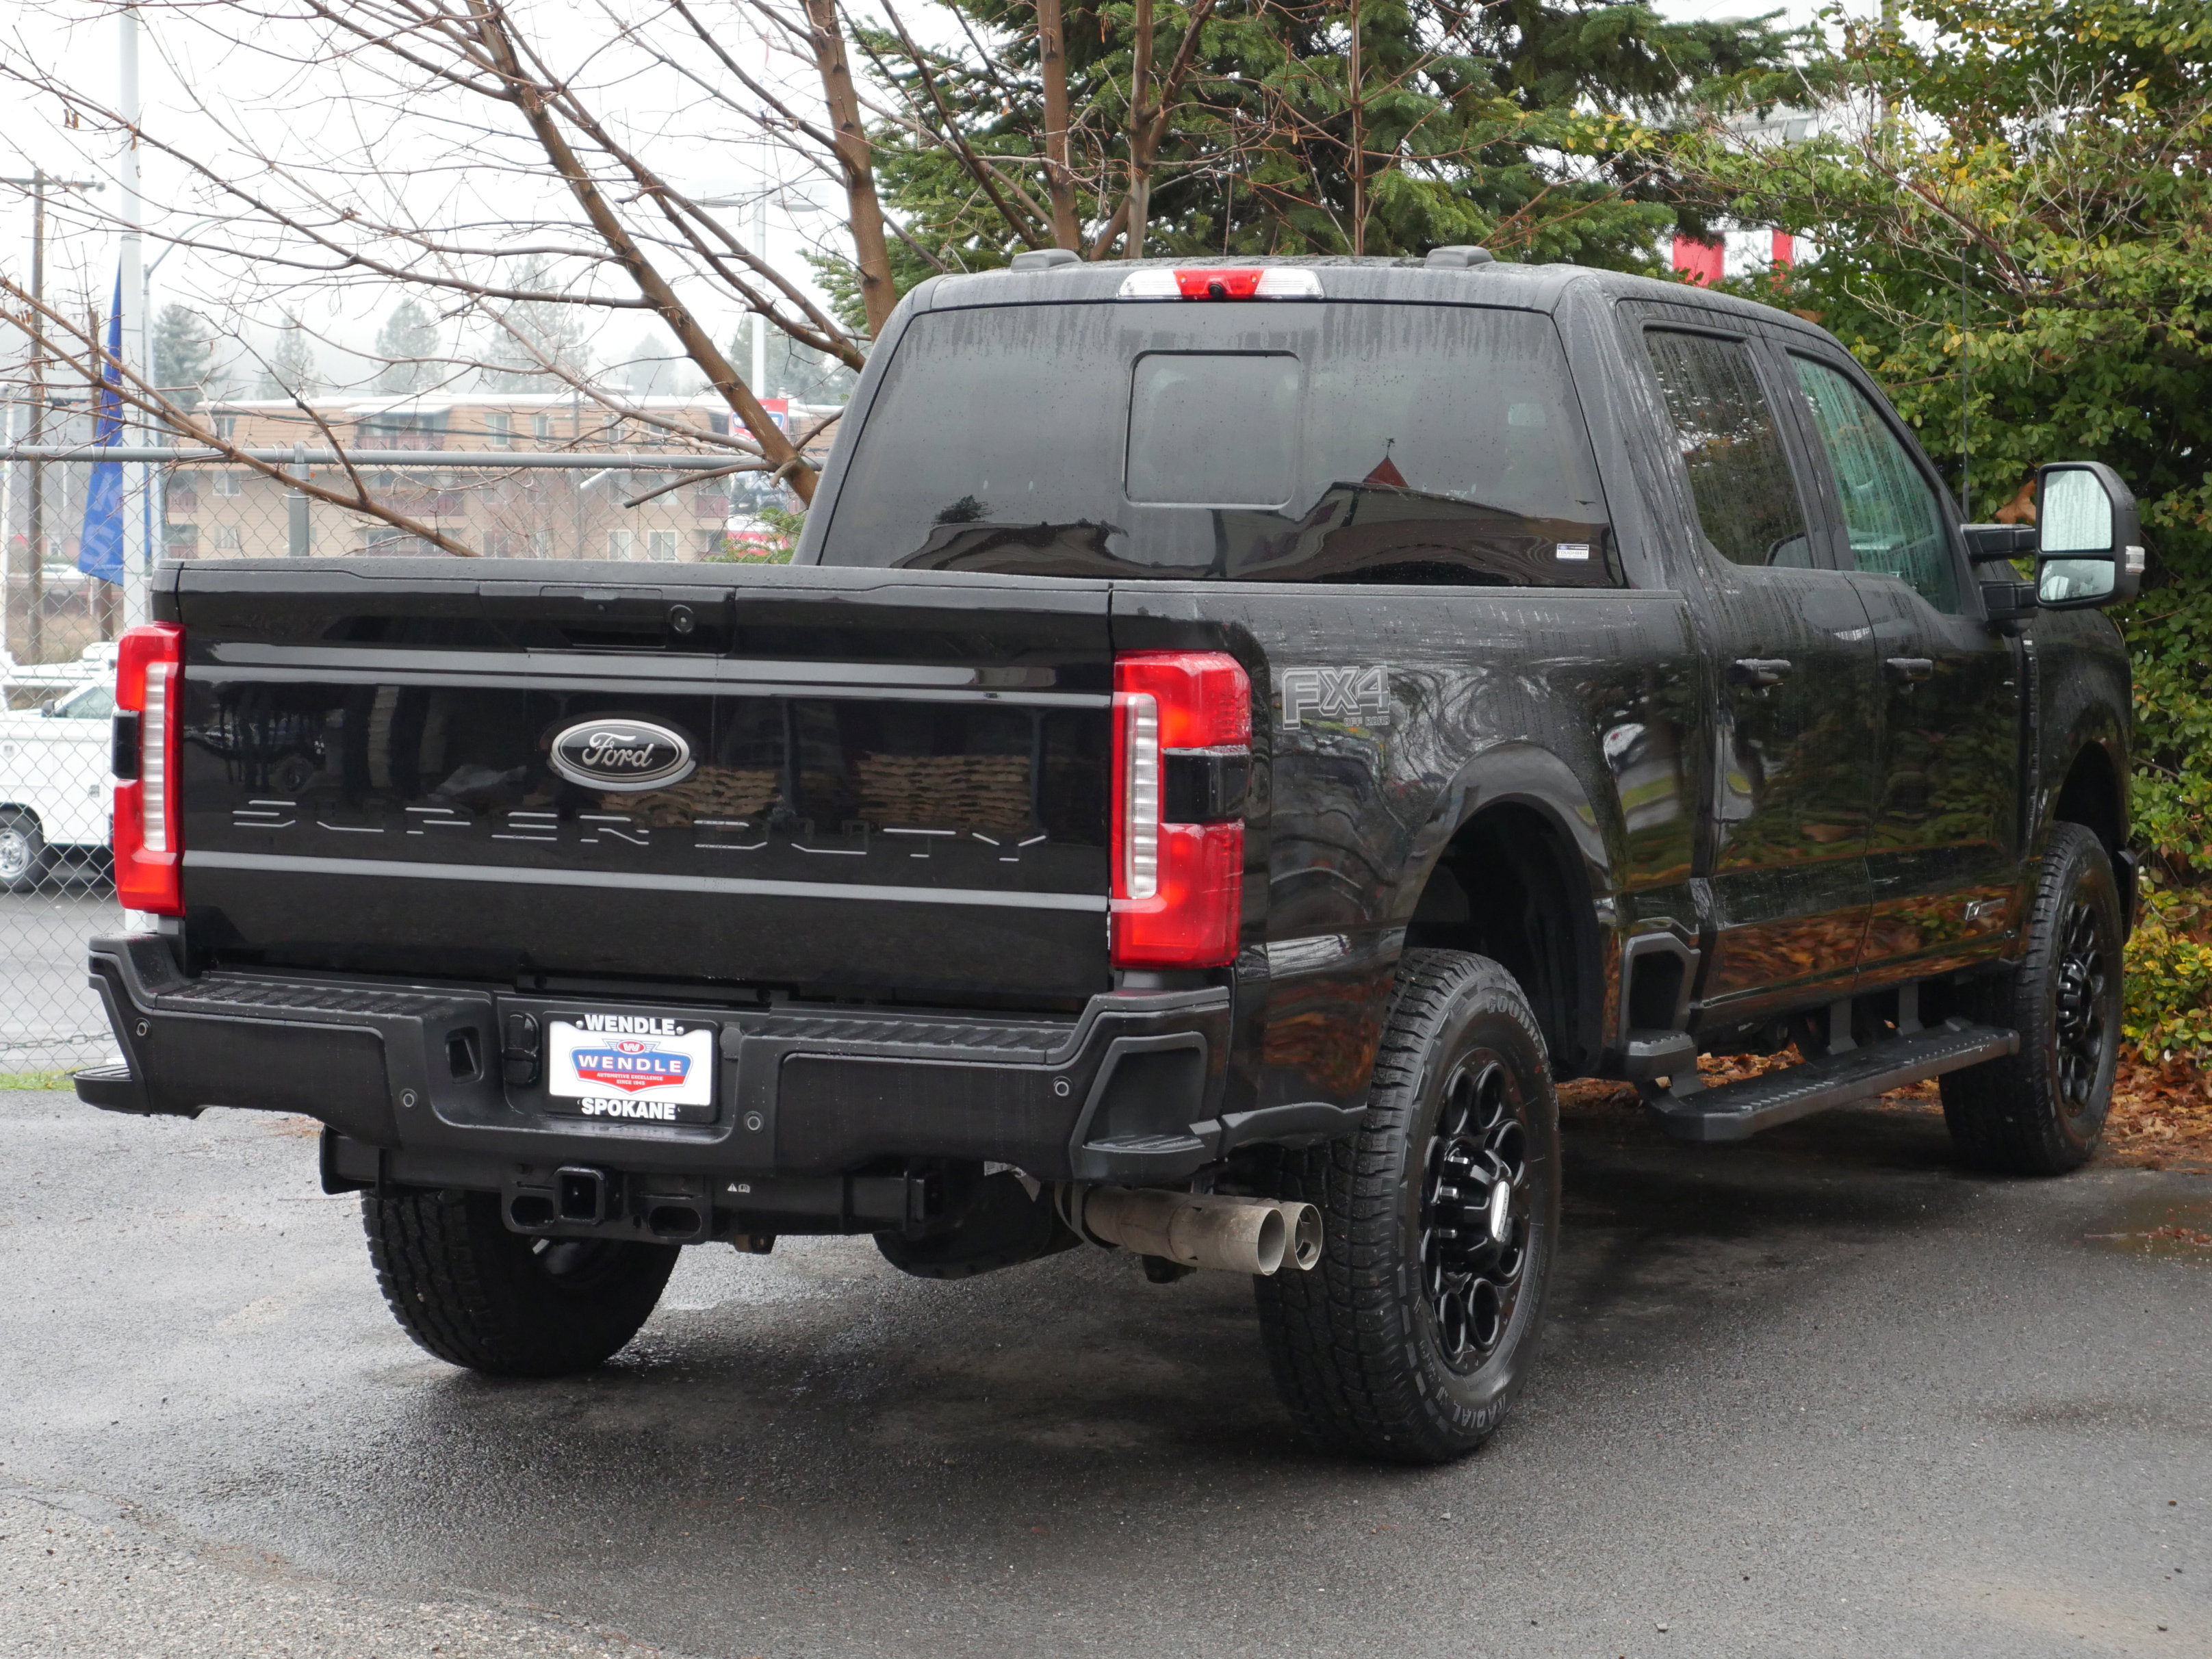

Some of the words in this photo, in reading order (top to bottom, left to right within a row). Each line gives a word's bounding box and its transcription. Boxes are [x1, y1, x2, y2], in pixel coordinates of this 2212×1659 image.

[1281, 665, 1391, 730] FX4
[582, 732, 654, 767] Ford
[584, 1014, 676, 1036] WENDLE
[578, 1055, 682, 1073] WENDLE
[581, 1097, 676, 1120] SPOKANE
